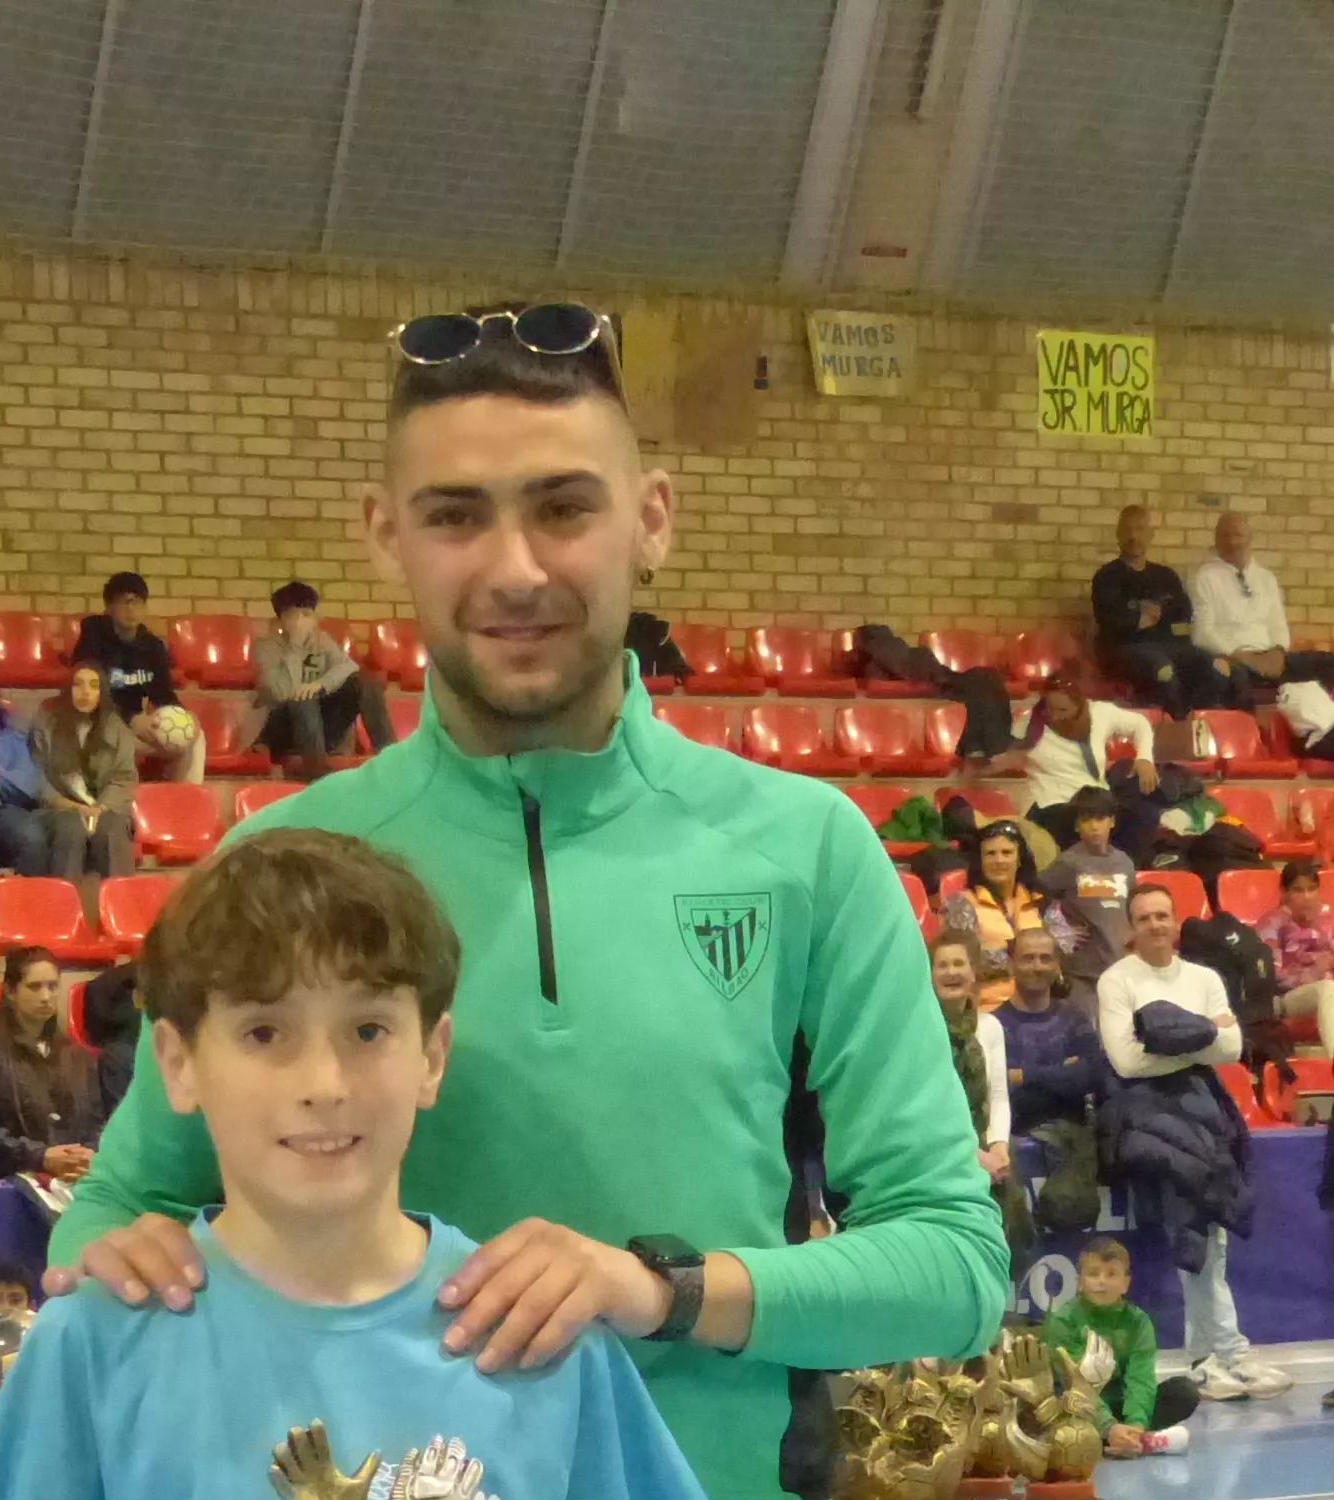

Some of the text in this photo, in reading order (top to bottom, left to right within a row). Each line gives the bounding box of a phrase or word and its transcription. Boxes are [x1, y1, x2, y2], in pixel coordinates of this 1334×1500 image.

[818, 322, 896, 349] VAMOS
[821, 354, 903, 379] MURGA
[1041, 338, 1150, 391] VAMOS
[1086, 391, 1153, 436] MURGA
